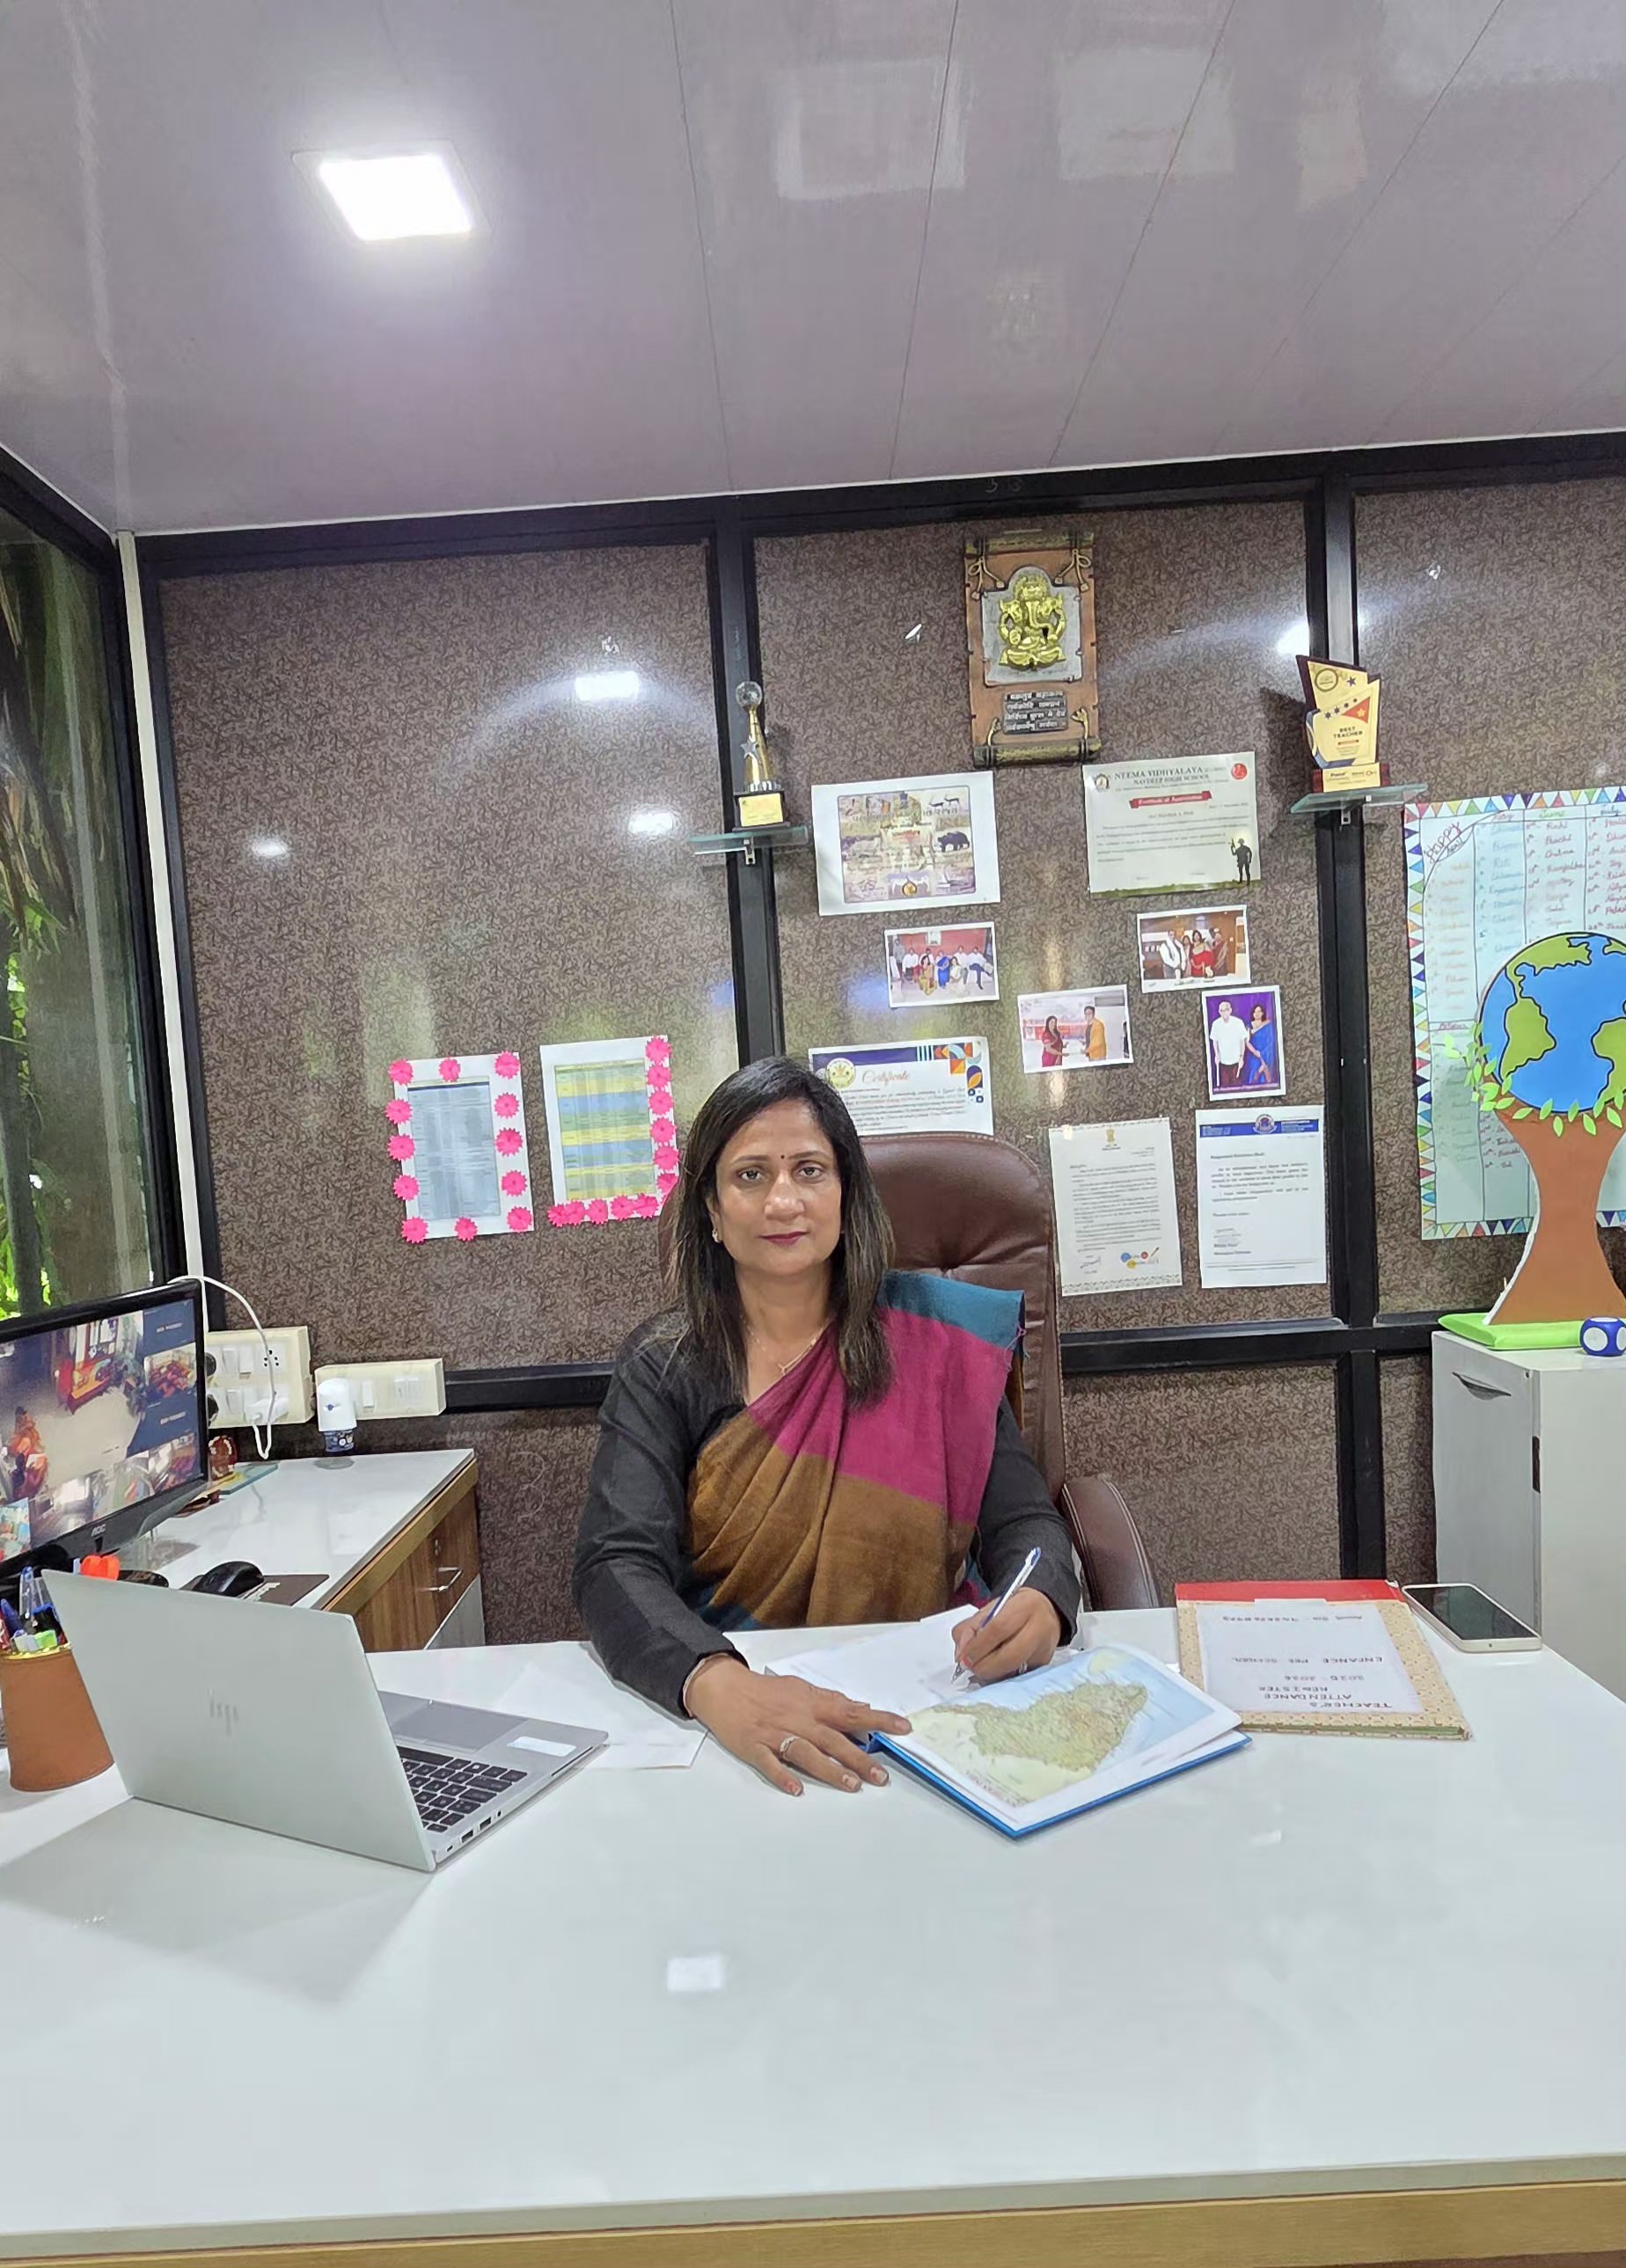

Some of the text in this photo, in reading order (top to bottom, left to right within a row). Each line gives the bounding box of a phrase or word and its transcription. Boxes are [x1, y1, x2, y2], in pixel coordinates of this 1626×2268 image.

[1333, 730, 1363, 739] TEACHER
[1114, 770, 1146, 780] NEEMA
[1147, 766, 1204, 778] VIDHYALAYA
[1424, 822, 1461, 864] Happy
[861, 1069, 911, 1086] Certificate
